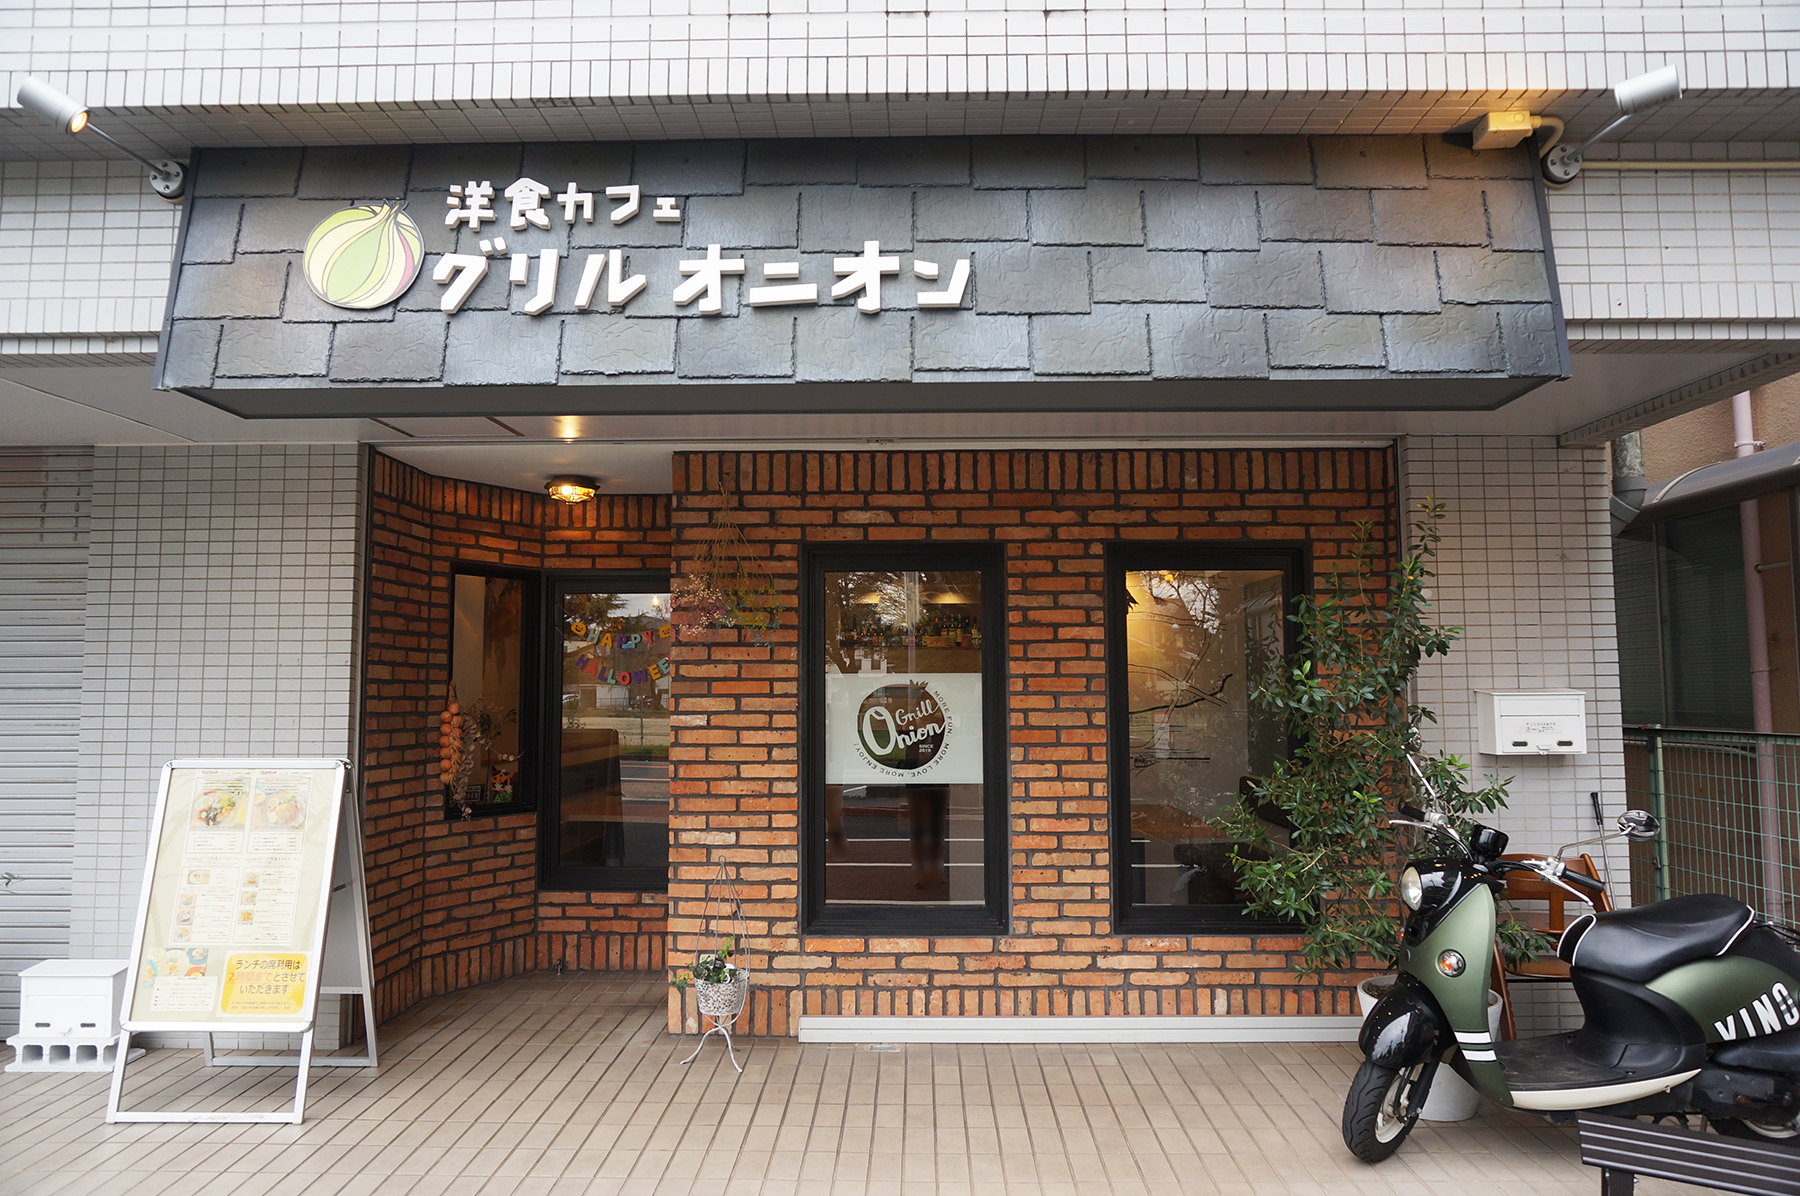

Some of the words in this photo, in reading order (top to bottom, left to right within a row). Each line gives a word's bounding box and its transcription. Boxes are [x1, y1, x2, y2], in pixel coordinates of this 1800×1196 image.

[445, 177, 681, 231] 洋食カフェ
[432, 237, 647, 316] グリル
[672, 240, 971, 315] オニオン
[587, 628, 653, 648] HAPPY
[574, 654, 671, 686] HALLOWEE
[895, 699, 939, 725] Grill
[934, 691, 950, 713] MORE
[862, 705, 946, 756] Onion
[934, 743, 950, 765] MORE
[879, 768, 904, 778] MORE
[236, 959, 301, 970] ランチの席利用は
[228, 972, 305, 982] 2時間までとさせて
[240, 984, 290, 994] いただきます
[1713, 982, 1800, 1041] VINO
